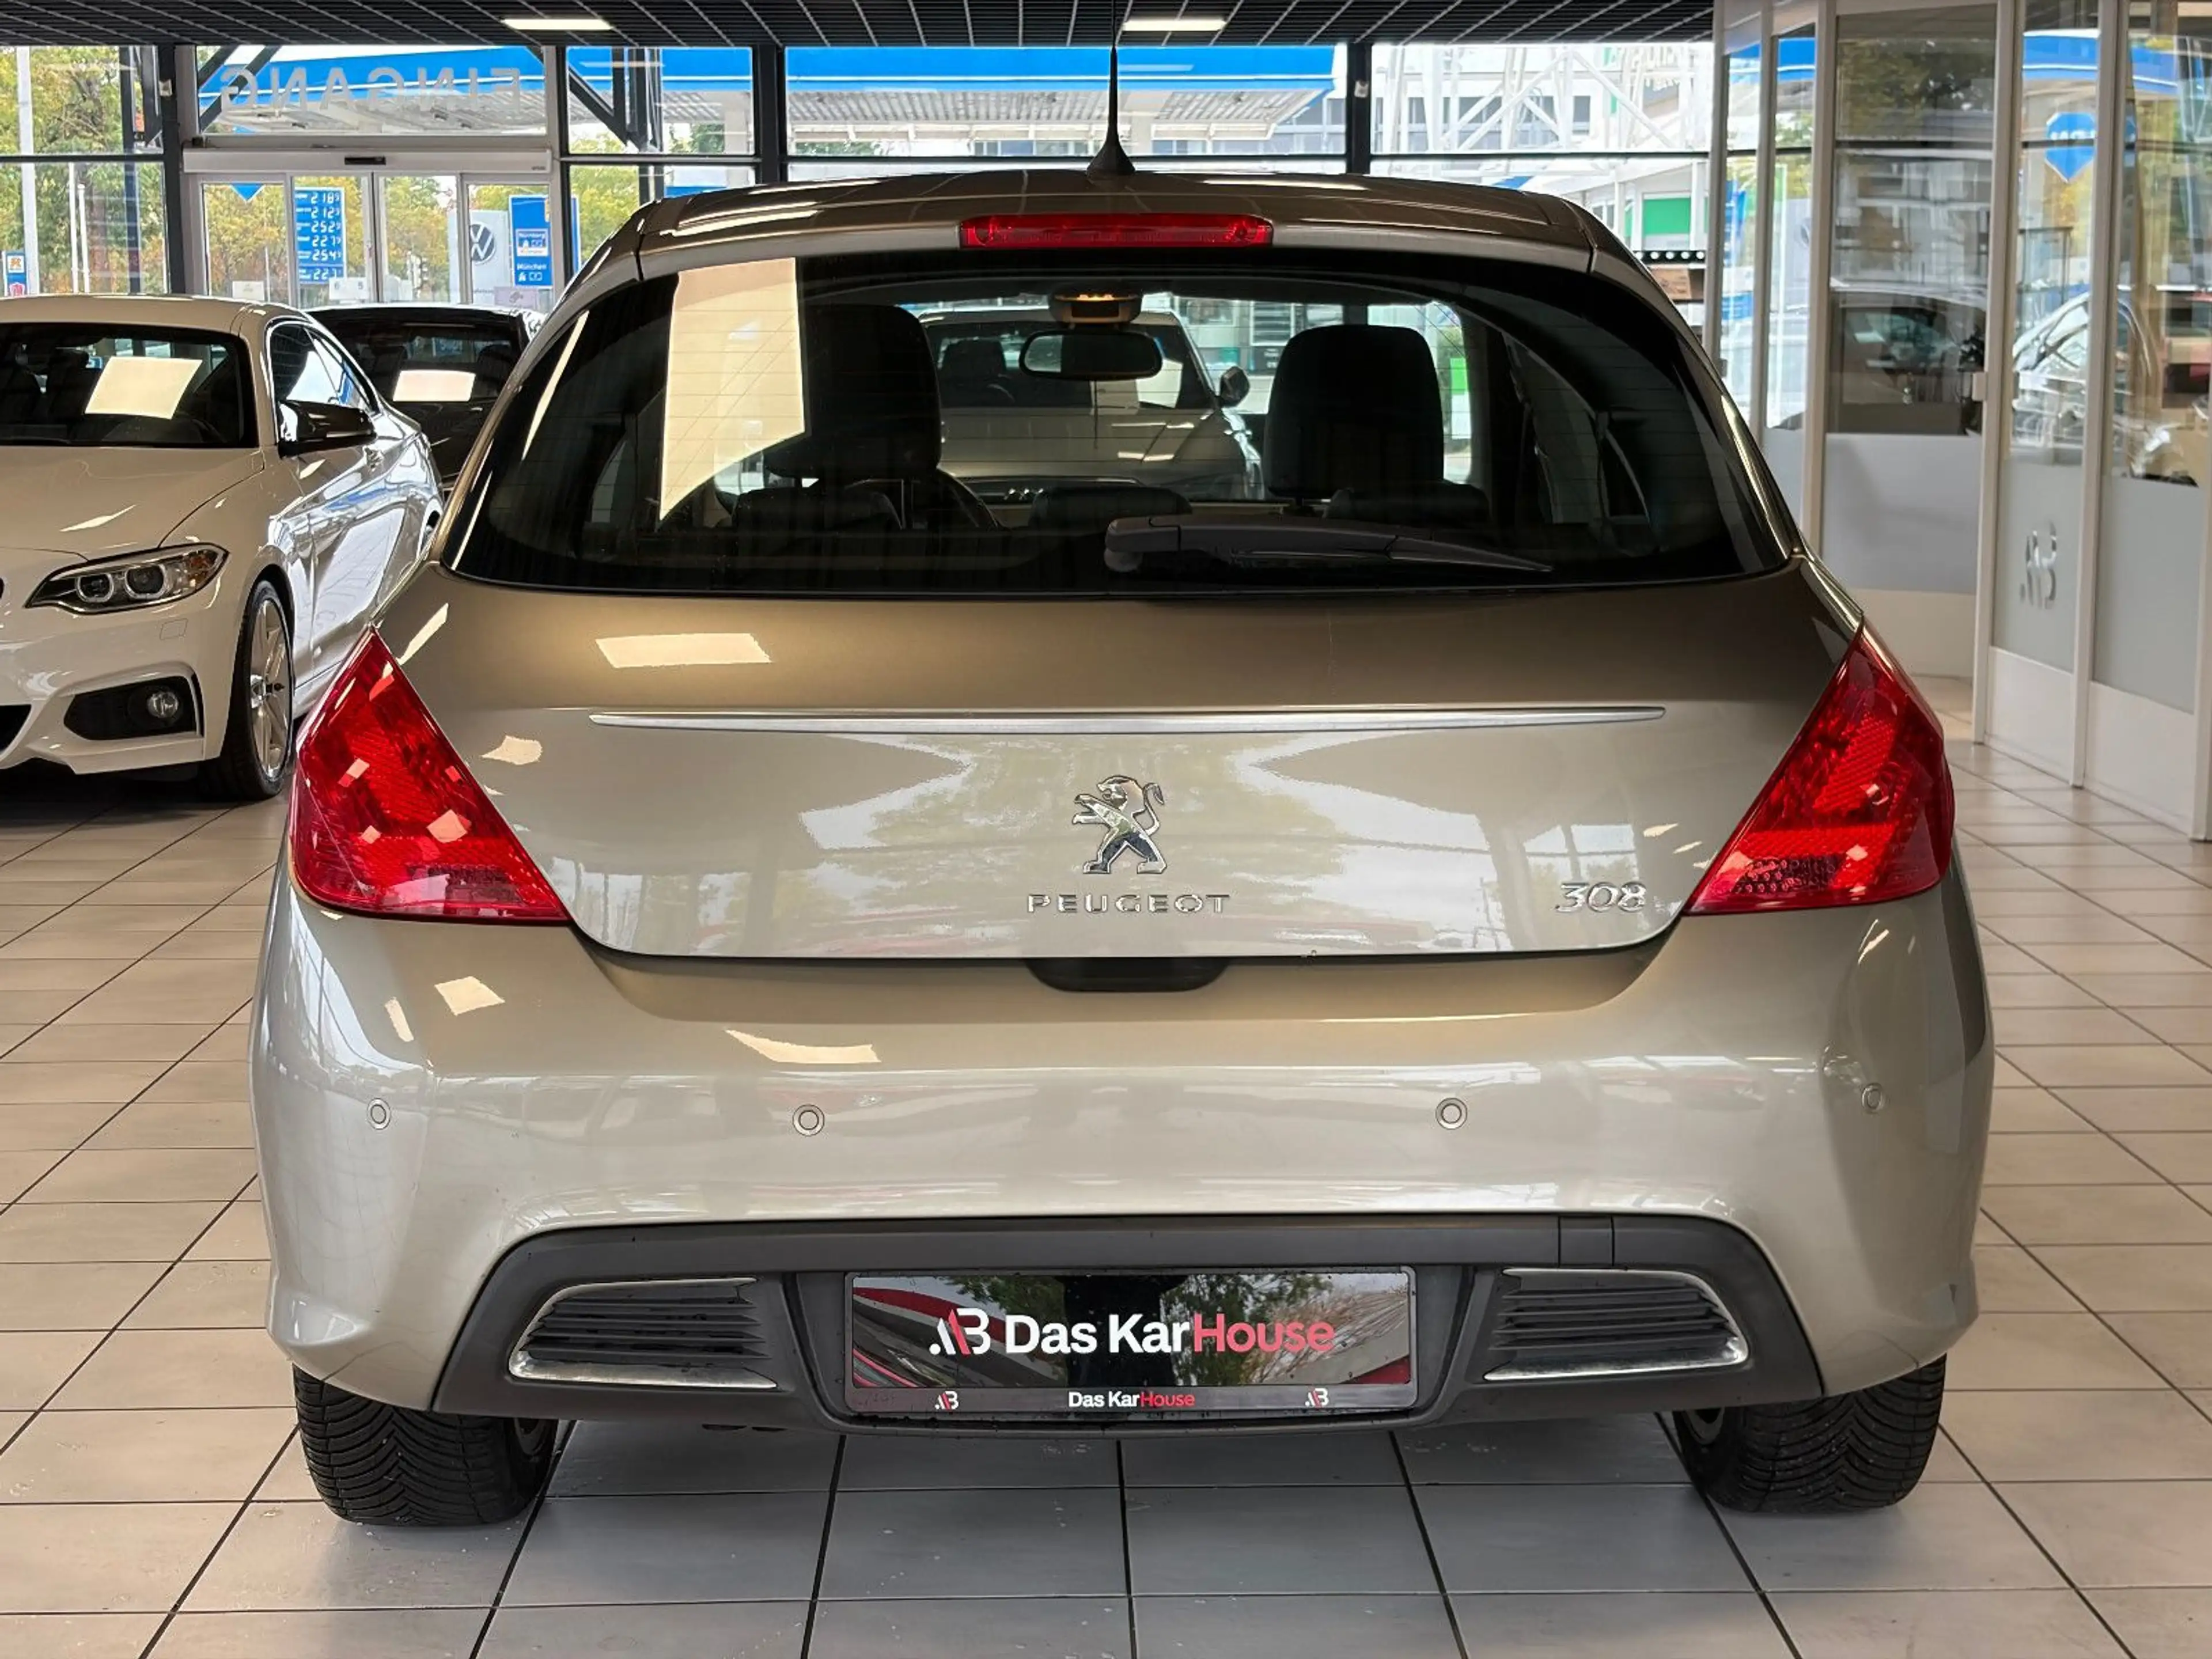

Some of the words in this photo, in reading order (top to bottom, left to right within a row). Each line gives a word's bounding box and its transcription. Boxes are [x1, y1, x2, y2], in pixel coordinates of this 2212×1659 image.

[1028, 893, 1230, 913] PEUGEOT
[1554, 881, 1646, 912] 308
[1005, 1314, 1098, 1354] Das
[1108, 1312, 1336, 1353] KarHouse
[1069, 1391, 1105, 1407] Das
[1108, 1391, 1196, 1407] KarHouse
